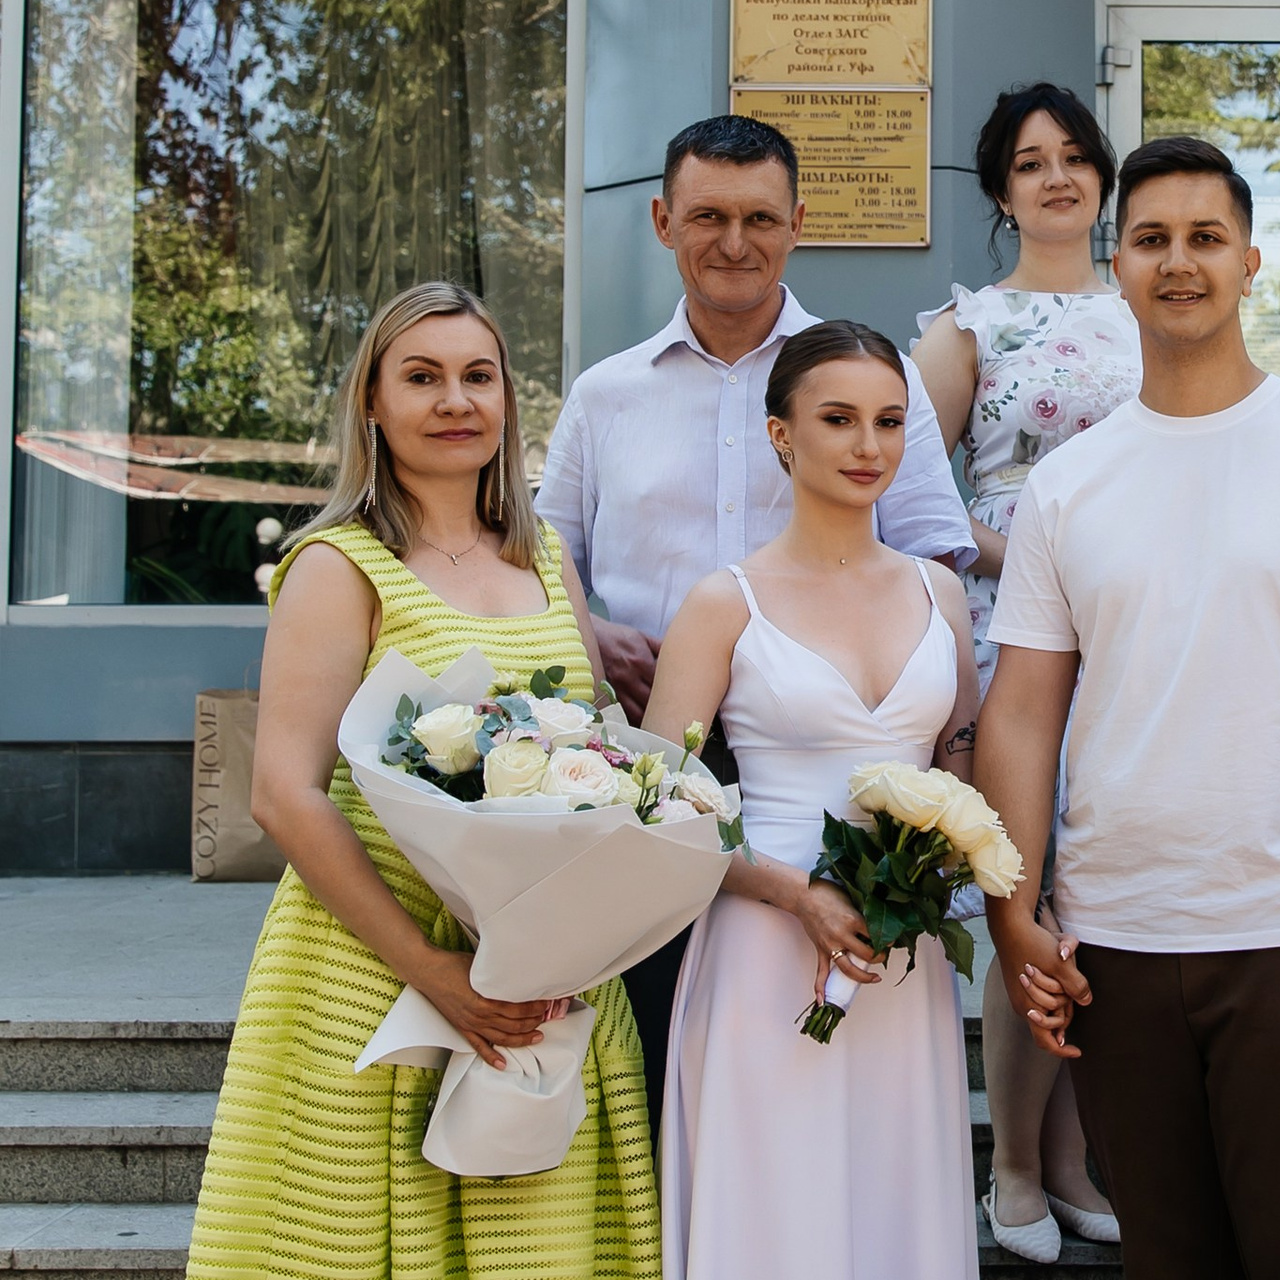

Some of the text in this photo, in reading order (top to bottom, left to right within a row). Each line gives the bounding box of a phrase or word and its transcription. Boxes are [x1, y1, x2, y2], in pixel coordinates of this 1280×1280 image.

[772, 13, 891, 23] по делам юстиции
[793, 28, 869, 39] Отдел ЗАГС
[795, 43, 867, 56] Советского
[787, 63, 874, 75] района г. Уфа
[854, 110, 875, 119] 9.00
[886, 110, 912, 119] 18.00
[850, 122, 875, 131] 13.00
[886, 122, 912, 131] 14.00
[829, 172, 894, 183] РАБОТЫ:
[858, 187, 879, 195] 9.00
[890, 187, 916, 196] 18.00
[854, 198, 881, 207] 13.00
[891, 198, 917, 207] 14.00
[195, 700, 221, 881] COZY HOME
